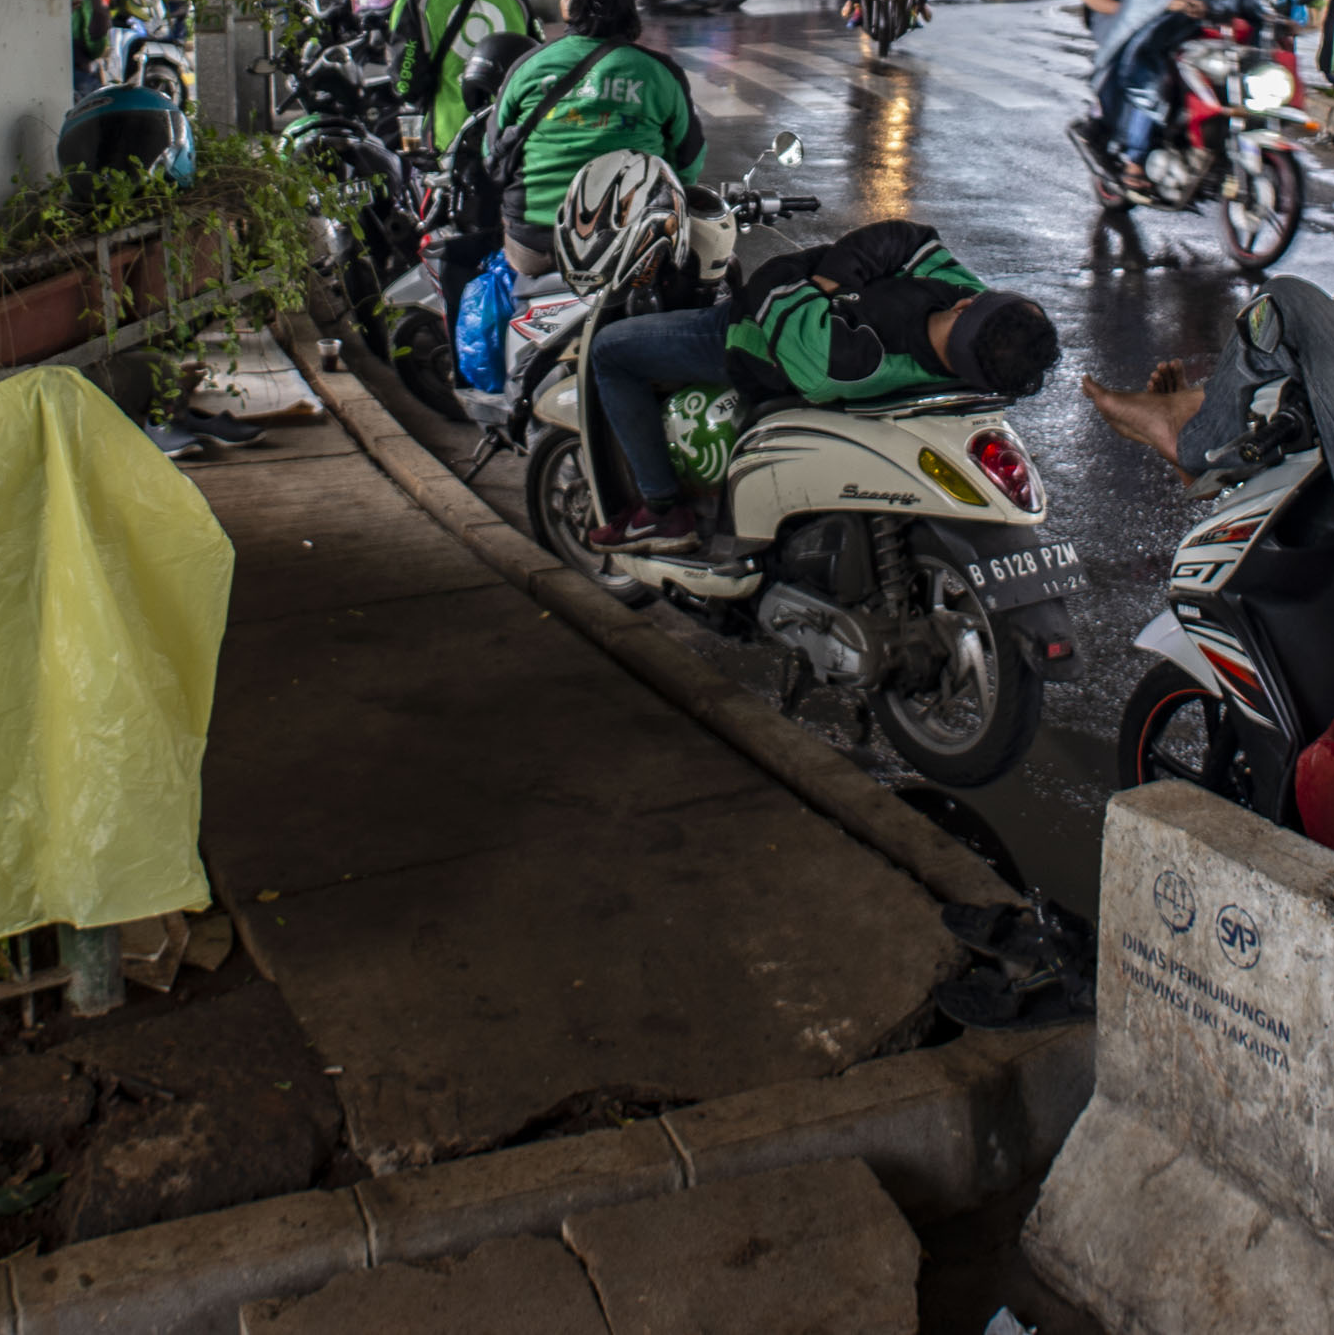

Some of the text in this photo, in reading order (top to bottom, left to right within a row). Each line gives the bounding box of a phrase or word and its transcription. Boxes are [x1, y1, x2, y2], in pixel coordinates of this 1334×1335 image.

[400, 40, 417, 80] gojek
[969, 541, 1080, 587] B 6128 PZM
[1122, 959, 1291, 1074] PROVINSI DKI JAKARTA
[1123, 931, 1291, 1043] DINAS PERHUBUNGAN
